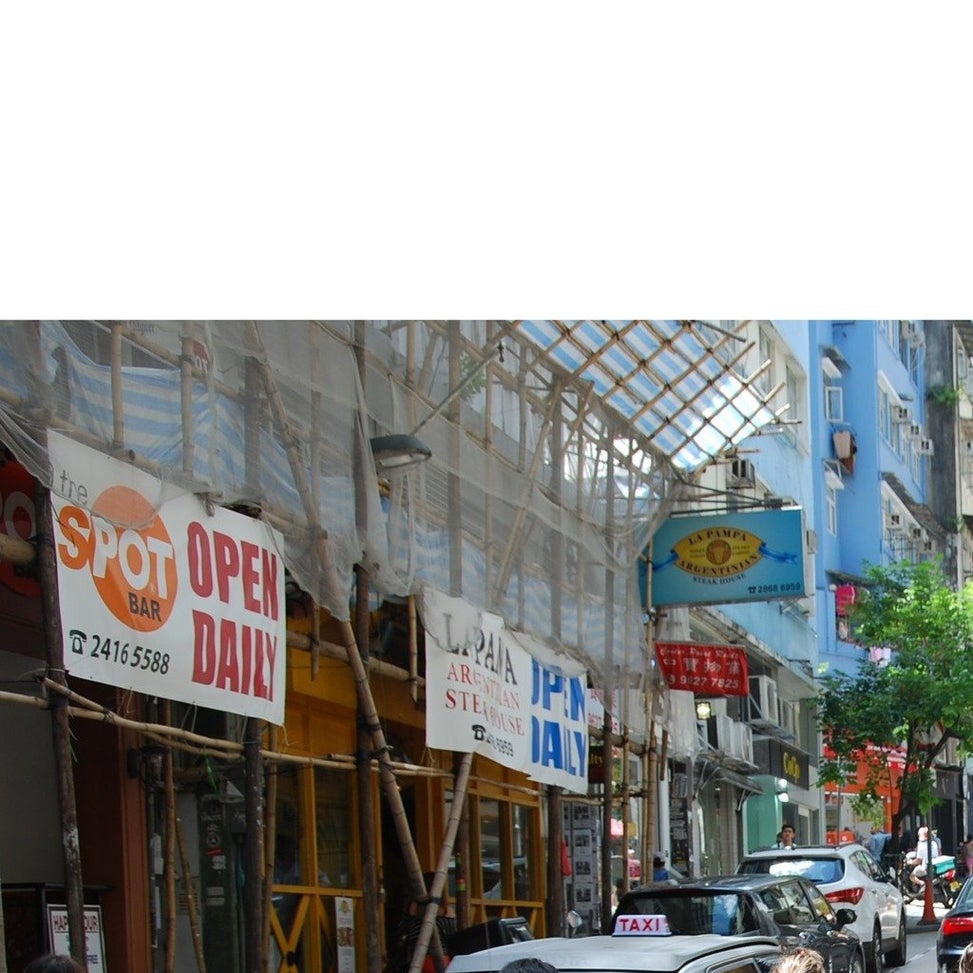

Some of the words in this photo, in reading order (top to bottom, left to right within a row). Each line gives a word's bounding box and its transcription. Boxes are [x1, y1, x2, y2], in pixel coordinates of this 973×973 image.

[688, 534, 703, 545] LA
[706, 529, 747, 541] PAMPA
[57, 505, 175, 600] SPOT
[680, 554, 758, 575] ARGENTINIAN
[187, 521, 279, 622] OPEN
[693, 576, 718, 585] STEAK
[720, 573, 746, 585] HOUSE
[128, 593, 162, 622] BAR
[90, 635, 129, 663] 2416
[130, 645, 170, 675] 5588
[191, 609, 278, 702] DAILY
[619, 918, 660, 932] TAXI
